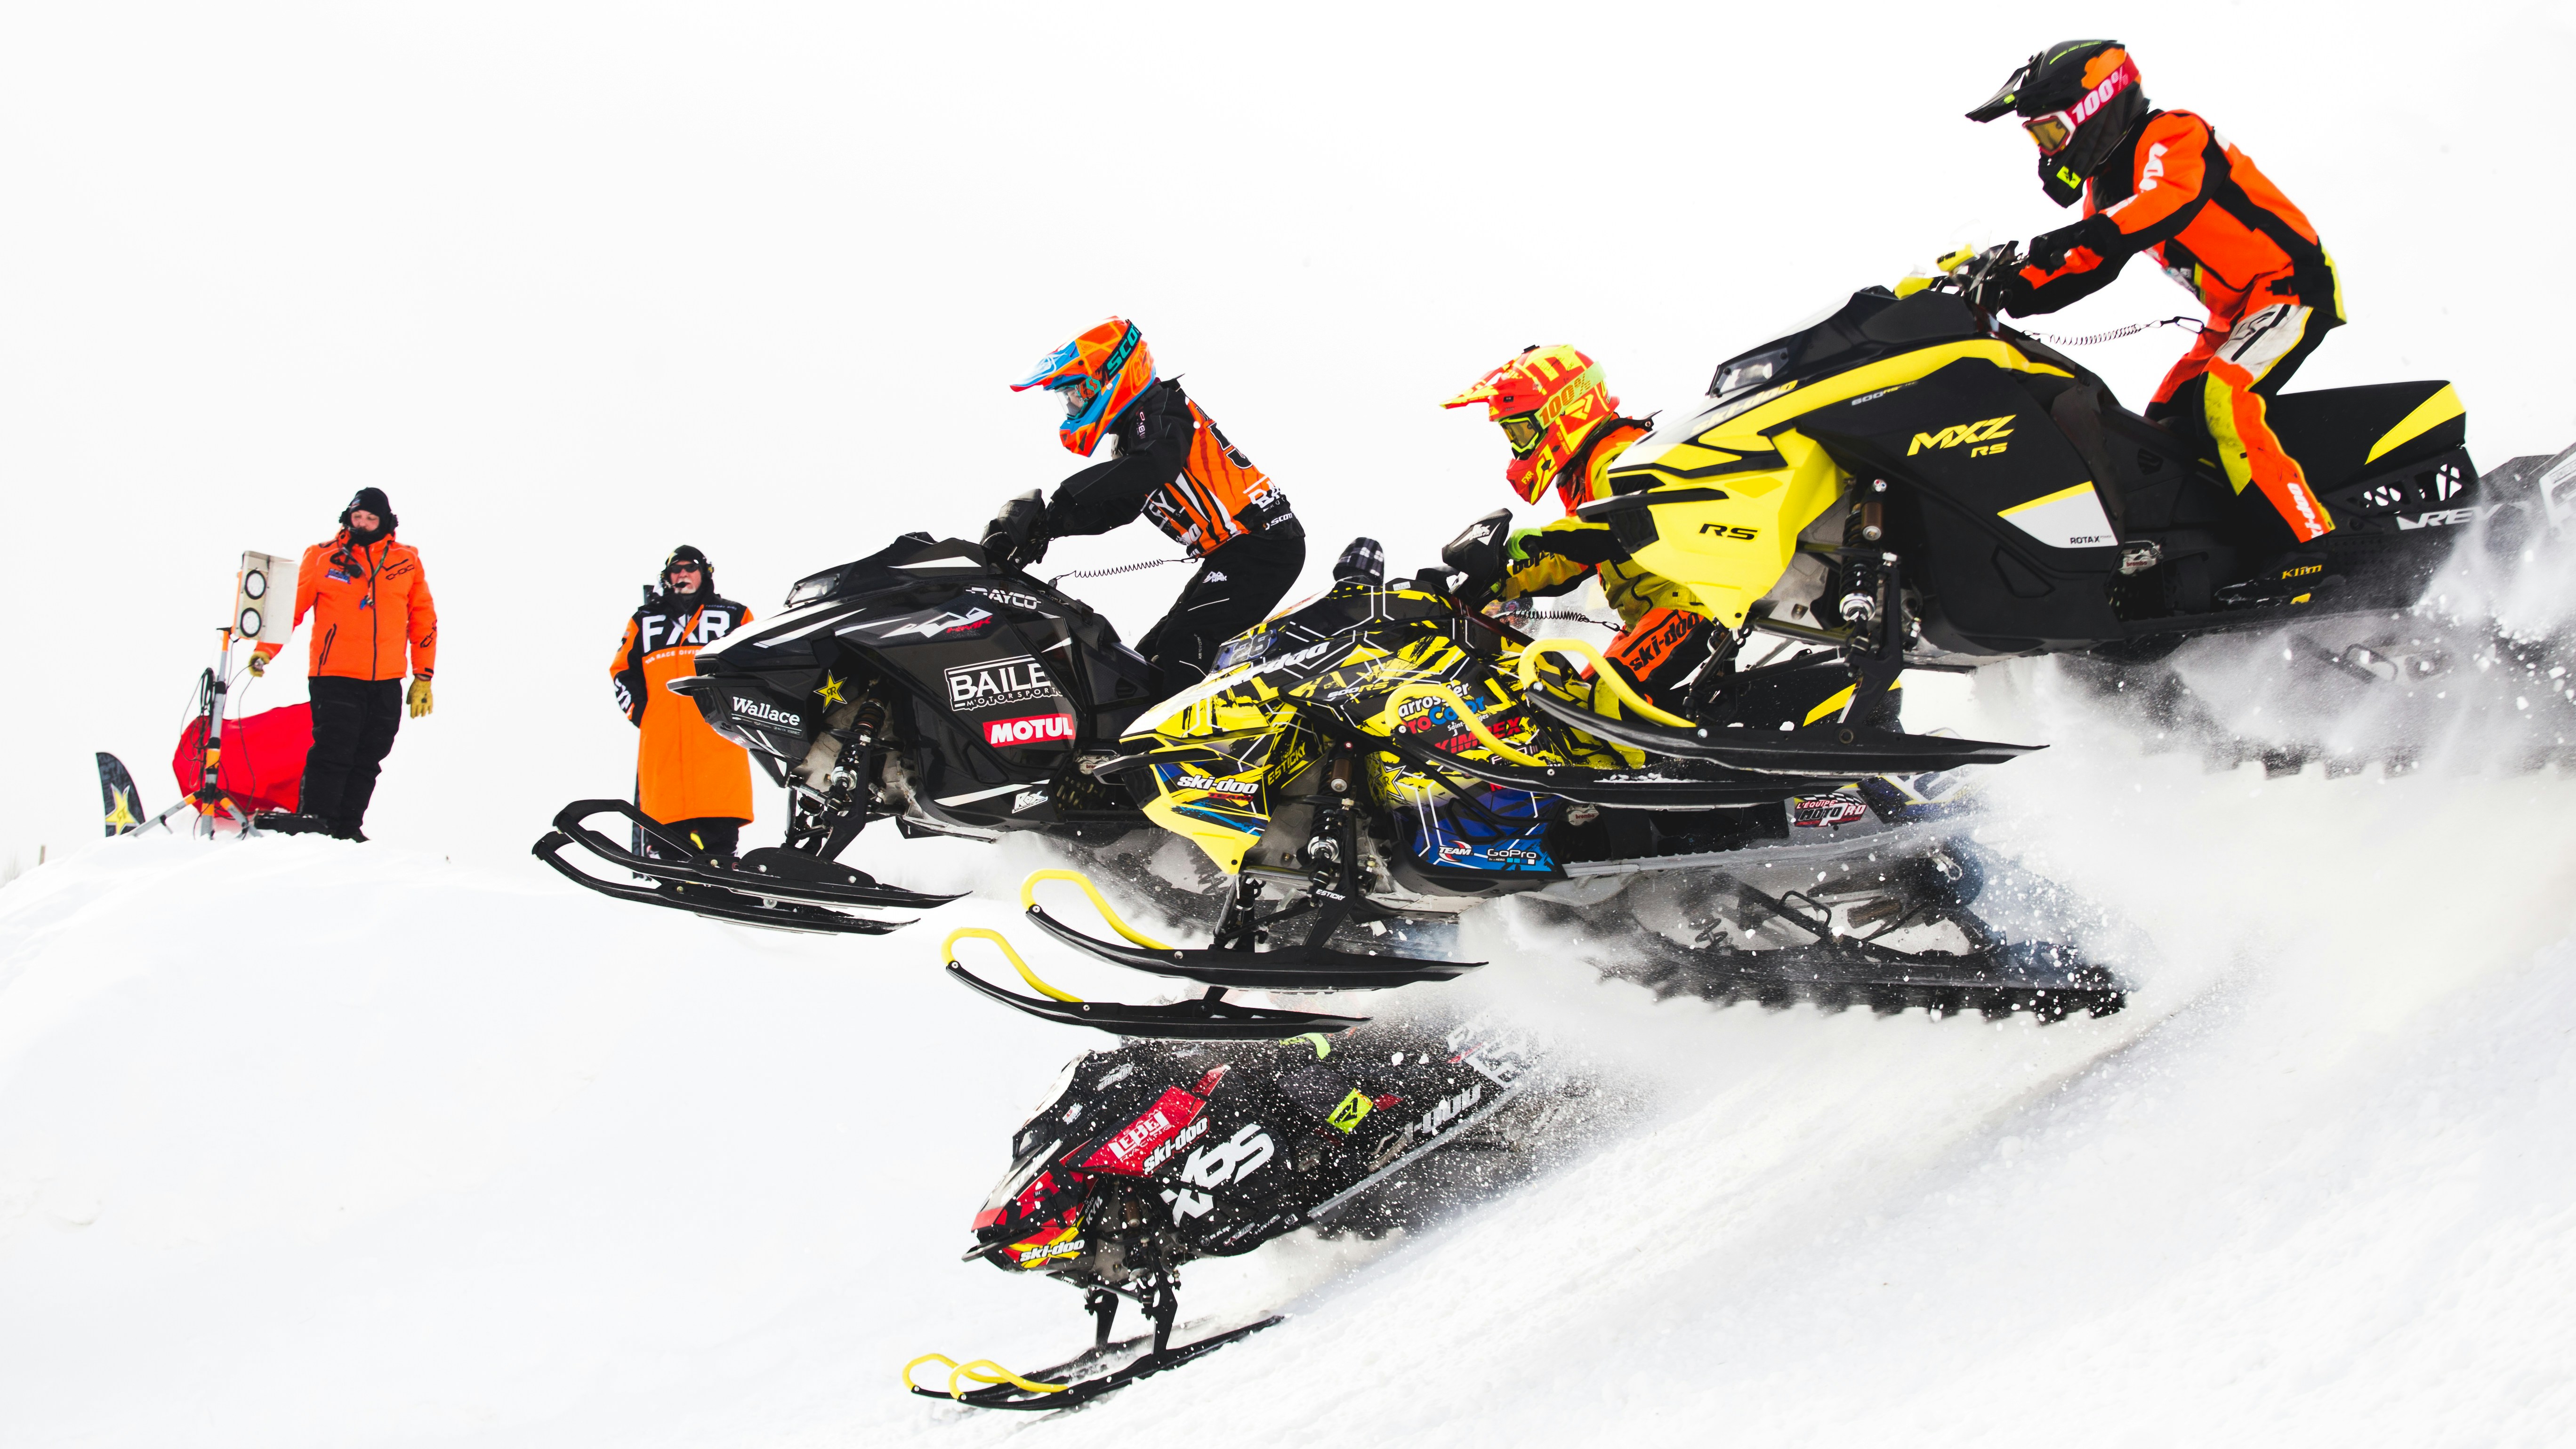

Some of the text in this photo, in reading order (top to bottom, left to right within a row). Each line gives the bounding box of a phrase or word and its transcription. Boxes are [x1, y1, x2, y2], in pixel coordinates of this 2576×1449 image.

[2071, 64, 2129, 124] 100%
[1539, 373, 1591, 426] 100%
[1907, 414, 2017, 456] MXZ
[1971, 442, 2008, 458] RS
[1521, 471, 1535, 485] FXR
[2287, 483, 2324, 539] ki-doo
[1699, 523, 1758, 540] RS
[2070, 536, 2100, 544] ROTAX
[642, 610, 730, 653] FXR
[950, 662, 1052, 701] BAILE
[966, 687, 1062, 707] MOTORSPORT
[733, 696, 800, 726] Wallace
[990, 717, 1073, 744] MOTUL
[1434, 716, 1521, 754] KIMEX
[1177, 775, 1259, 794] ski-doo
[1439, 847, 1472, 855] TEAM
[1487, 848, 1537, 859] GoPro
[1144, 1117, 1208, 1173] ski-doo
[1020, 1240, 1085, 1262] ski-doo
